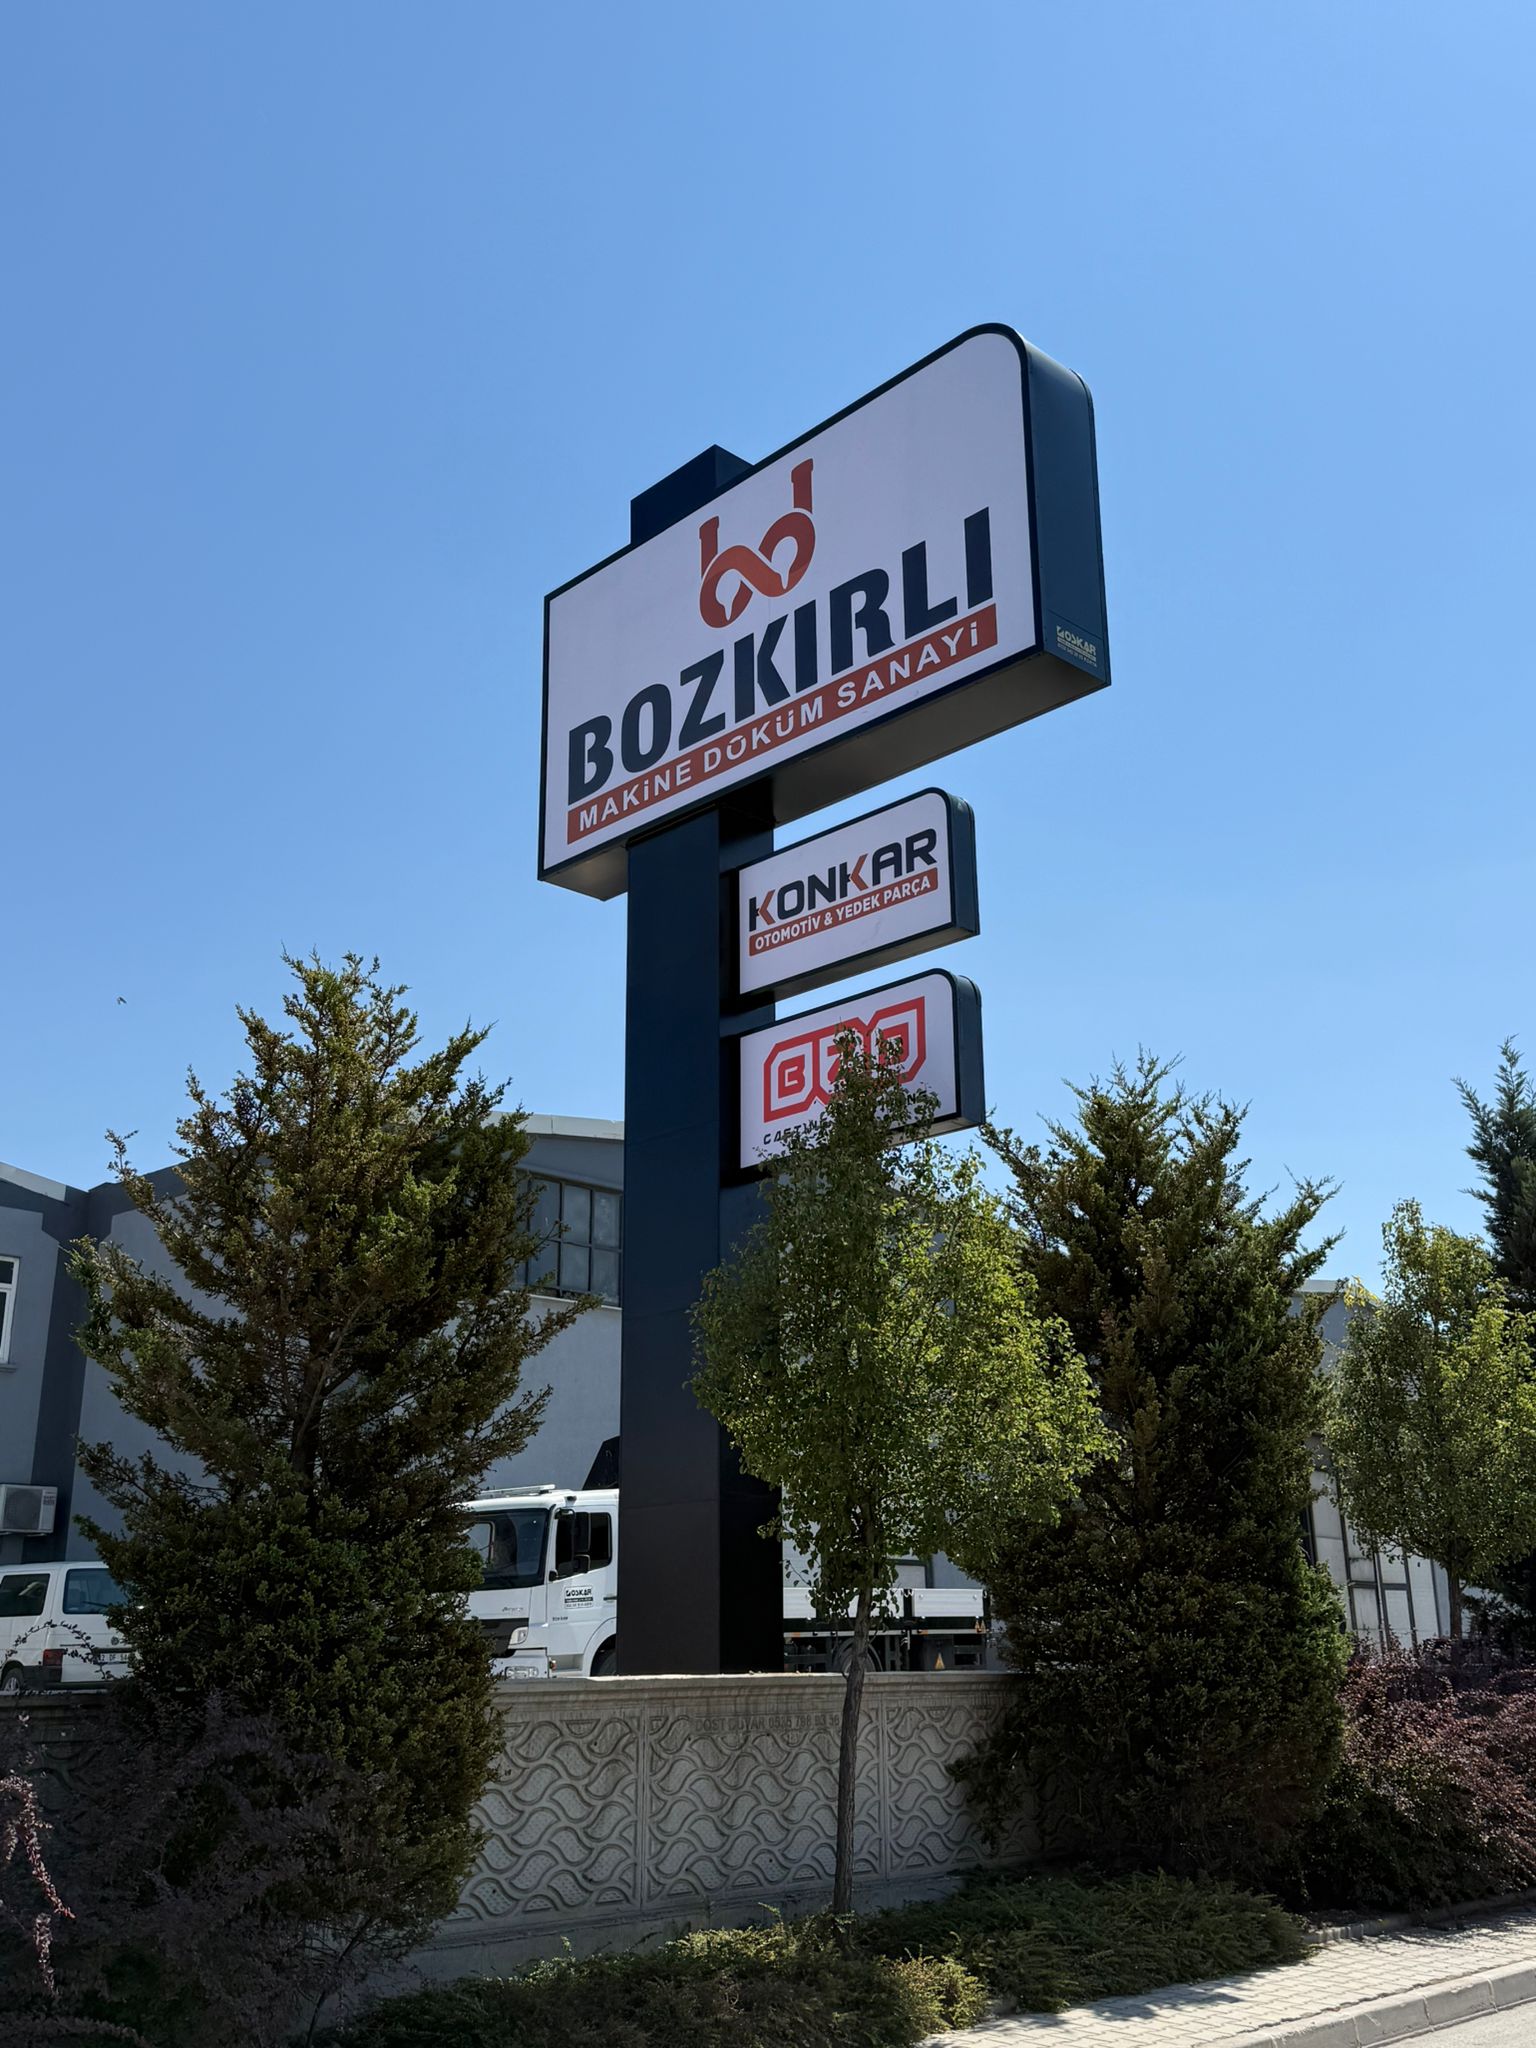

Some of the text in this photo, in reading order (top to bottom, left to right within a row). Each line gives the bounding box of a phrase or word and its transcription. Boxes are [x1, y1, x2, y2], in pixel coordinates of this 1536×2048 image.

[568, 506, 994, 806] BOZKIRLI
[578, 621, 978, 832] MAKİNE DÖKÜM SANAYİ
[749, 828, 937, 932] KONKAR
[755, 876, 931, 950] OTOMOTİV & YEDEK PARÇA
